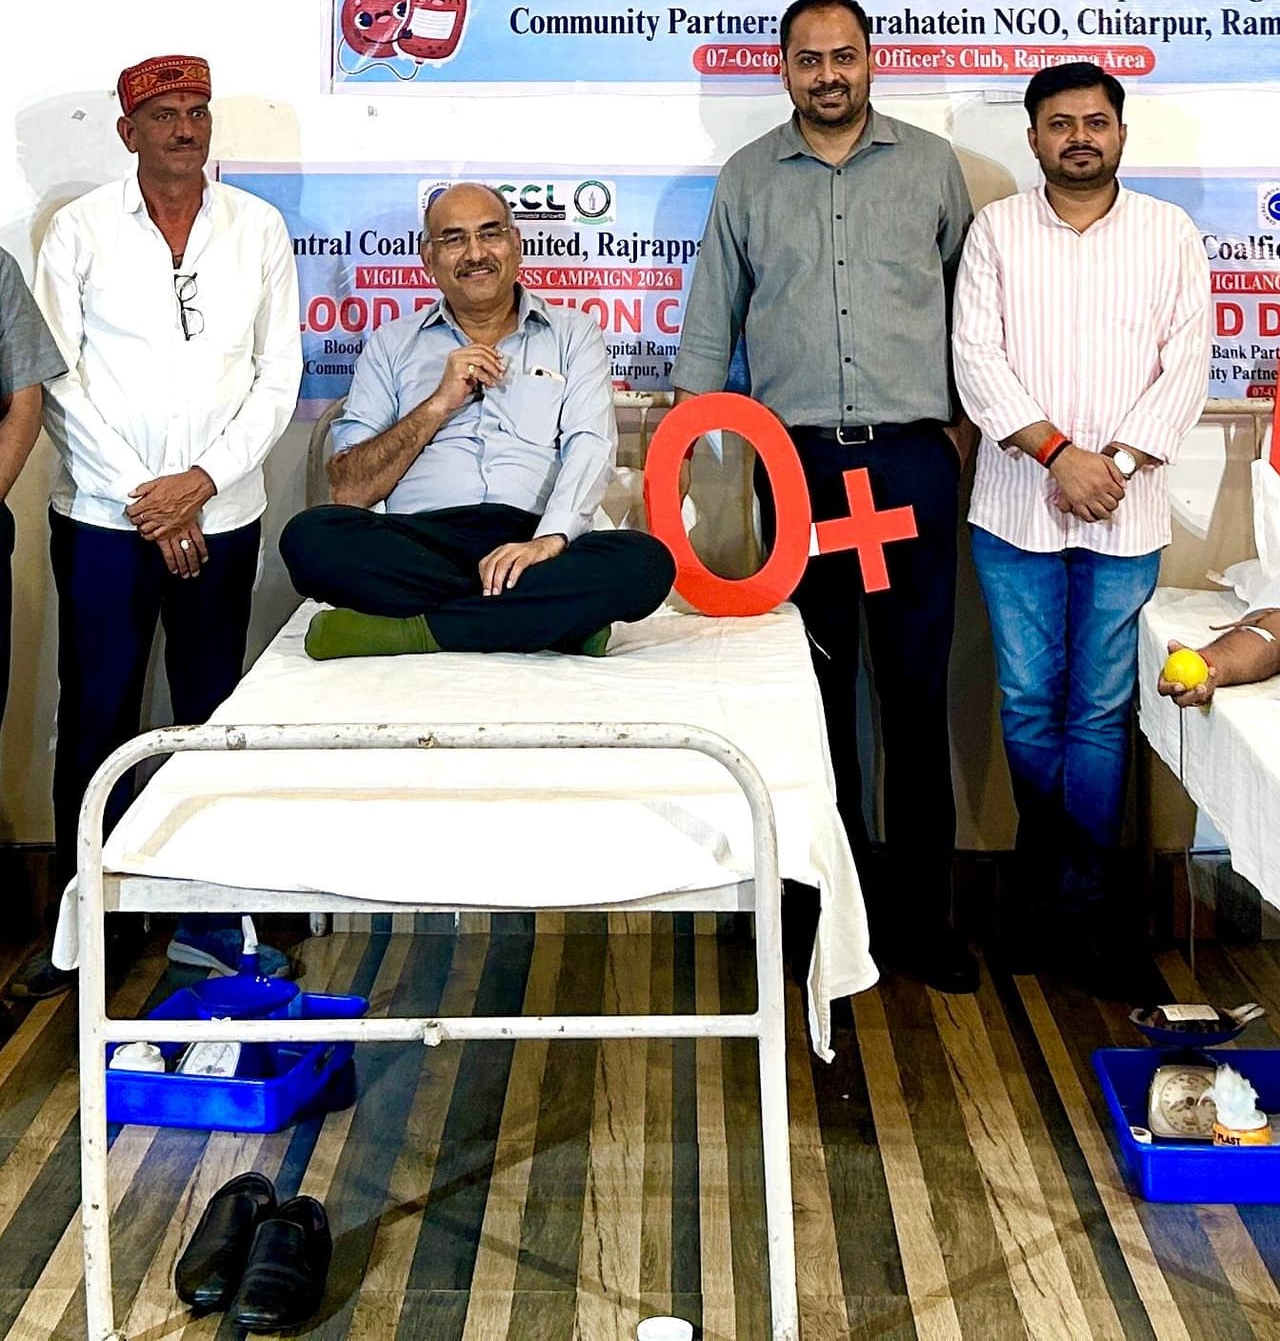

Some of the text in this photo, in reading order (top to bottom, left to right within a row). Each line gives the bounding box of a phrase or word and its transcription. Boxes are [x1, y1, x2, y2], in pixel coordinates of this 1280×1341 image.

[509, 7, 659, 42] Community
[668, 7, 778, 36] Partner:
[869, 8, 986, 35] urahatein
[995, 8, 1068, 41] NGO,
[1077, 7, 1213, 43] Chitarpur,
[959, 48, 1009, 70] Club,
[1101, 49, 1146, 68] Area
[293, 230, 351, 256] ntral
[546, 270, 632, 287] CAMPAIGN
[637, 271, 674, 287] 2026
[324, 339, 363, 355] Blood
[606, 341, 641, 359] spital
[1212, 344, 1247, 359] Bank
[610, 361, 660, 380] itarpur,
